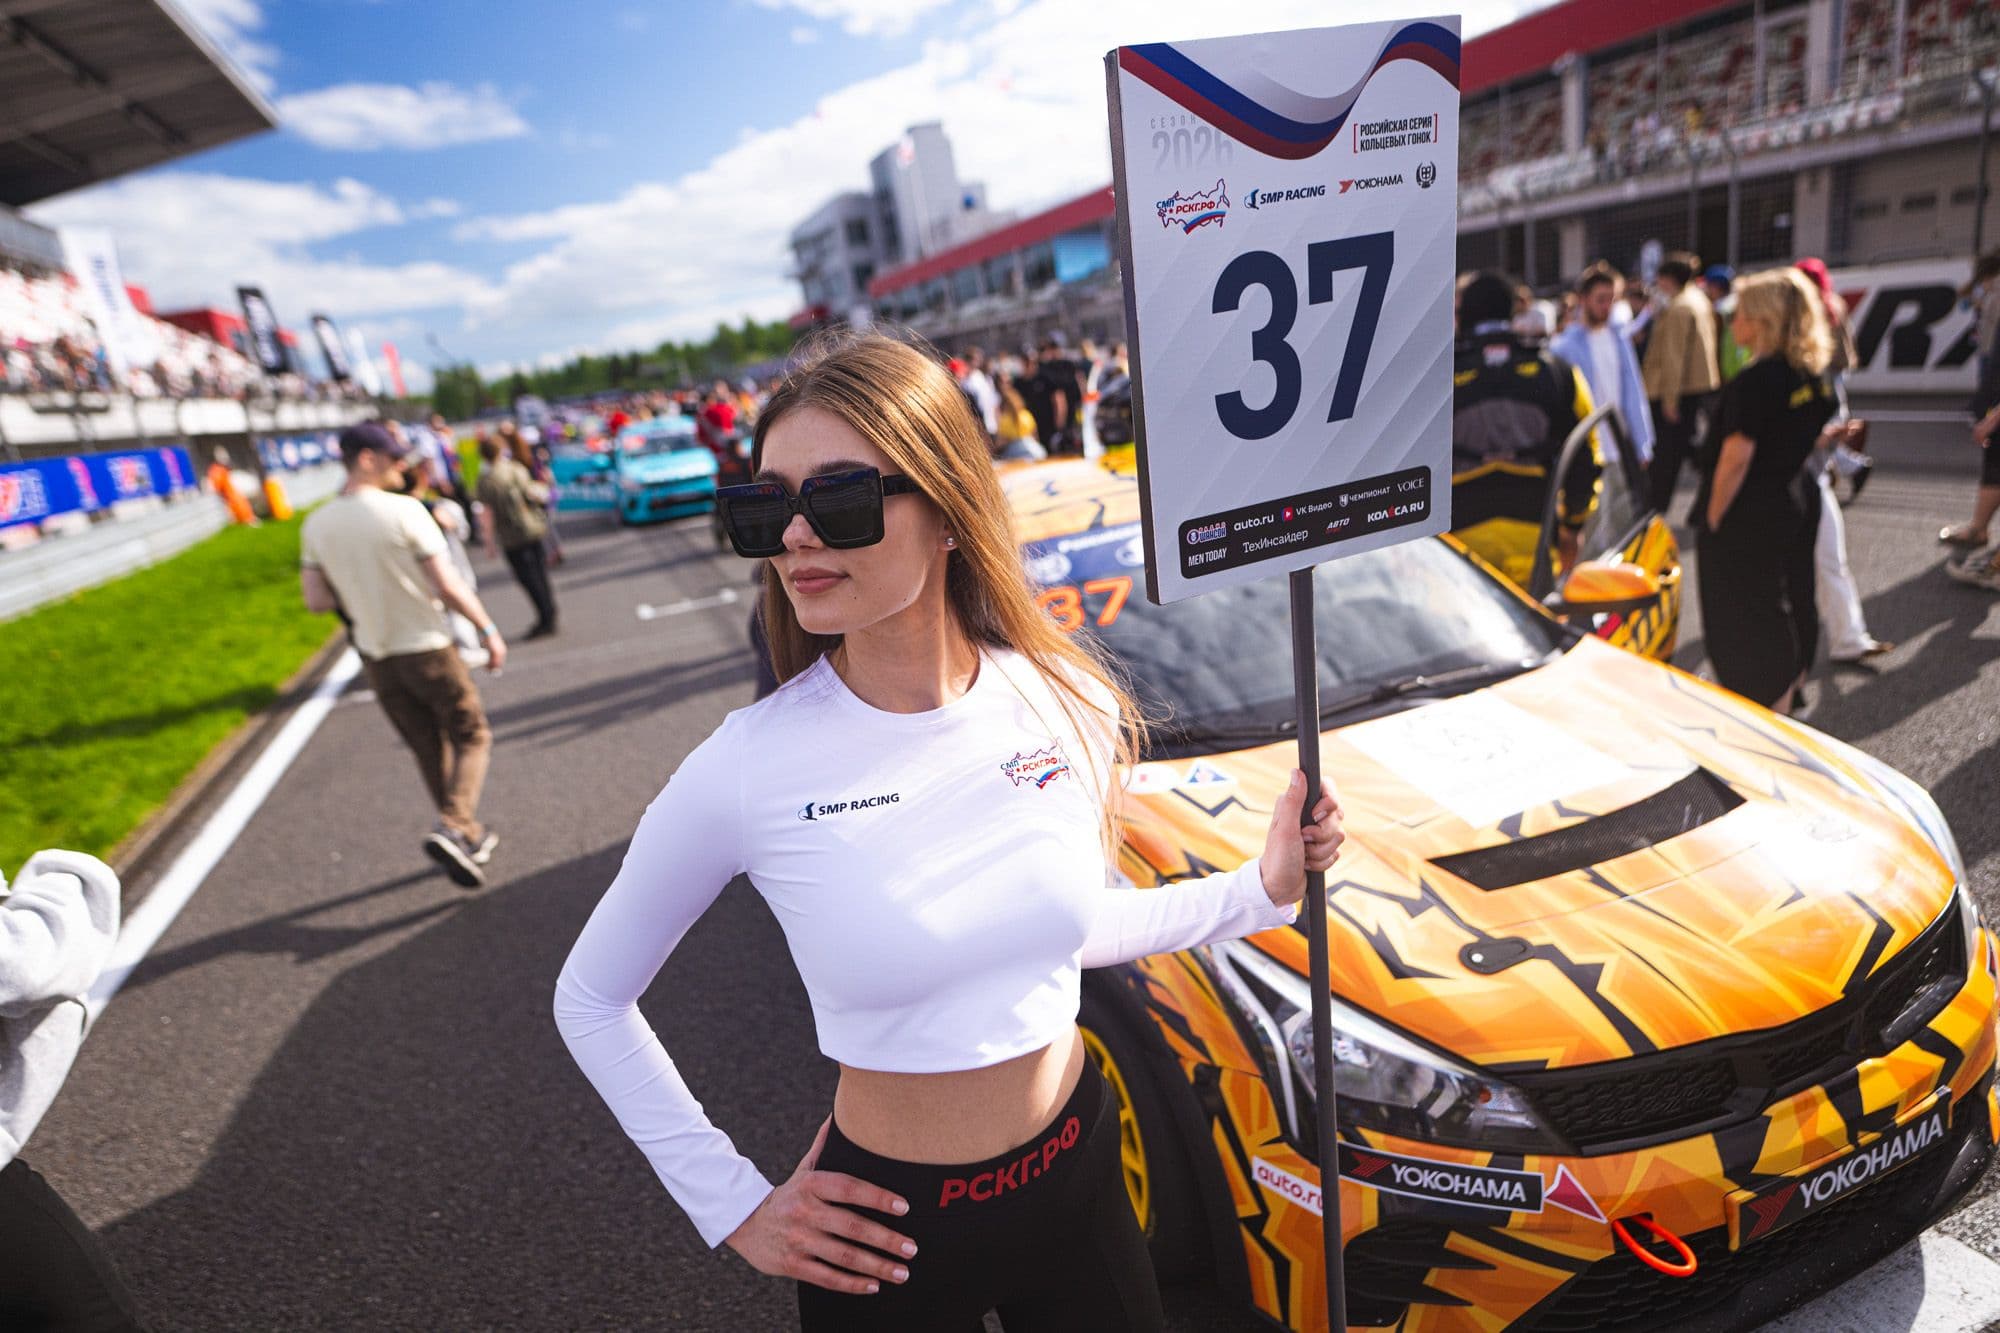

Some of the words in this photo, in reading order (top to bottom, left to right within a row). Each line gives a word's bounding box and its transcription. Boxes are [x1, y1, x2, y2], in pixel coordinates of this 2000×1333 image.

[1360, 118, 1408, 137] РОССИЙСКАЯ
[1409, 115, 1433, 131] СЕРИЯ
[1152, 125, 1234, 174] 2026
[1360, 135, 1406, 152] КОЛЬЦЕВЫХ
[1408, 131, 1431, 145] ГОНОК
[1354, 174, 1404, 190] YOKOHAMA
[1156, 199, 1174, 209] СМП
[1260, 191, 1284, 205] SMP
[1285, 185, 1326, 201] RACING
[1176, 201, 1216, 214] РСКГ.РФ
[1212, 231, 1394, 440] 37
[1349, 486, 1391, 502] ЧЕМПИОНАТ
[1397, 477, 1425, 493] VOICE
[1296, 506, 1307, 516] VK
[1308, 501, 1333, 513] Видео
[1233, 514, 1275, 532] auto.ru
[1242, 529, 1309, 553] ТехИнсайдер
[1188, 552, 1205, 567] MEN
[1205, 547, 1228, 562] TODAY
[1036, 576, 1132, 633] 37
[1000, 759, 1019, 770] СМП
[1022, 757, 1057, 772] РСКГ.РФ
[818, 803, 848, 816] SMP
[850, 793, 900, 811] RACING
[939, 1116, 1081, 1208] РСКГ.РФ
[1800, 1113, 1944, 1208] YOKOHAMA
[1391, 1163, 1527, 1203] YOKOHAMA
